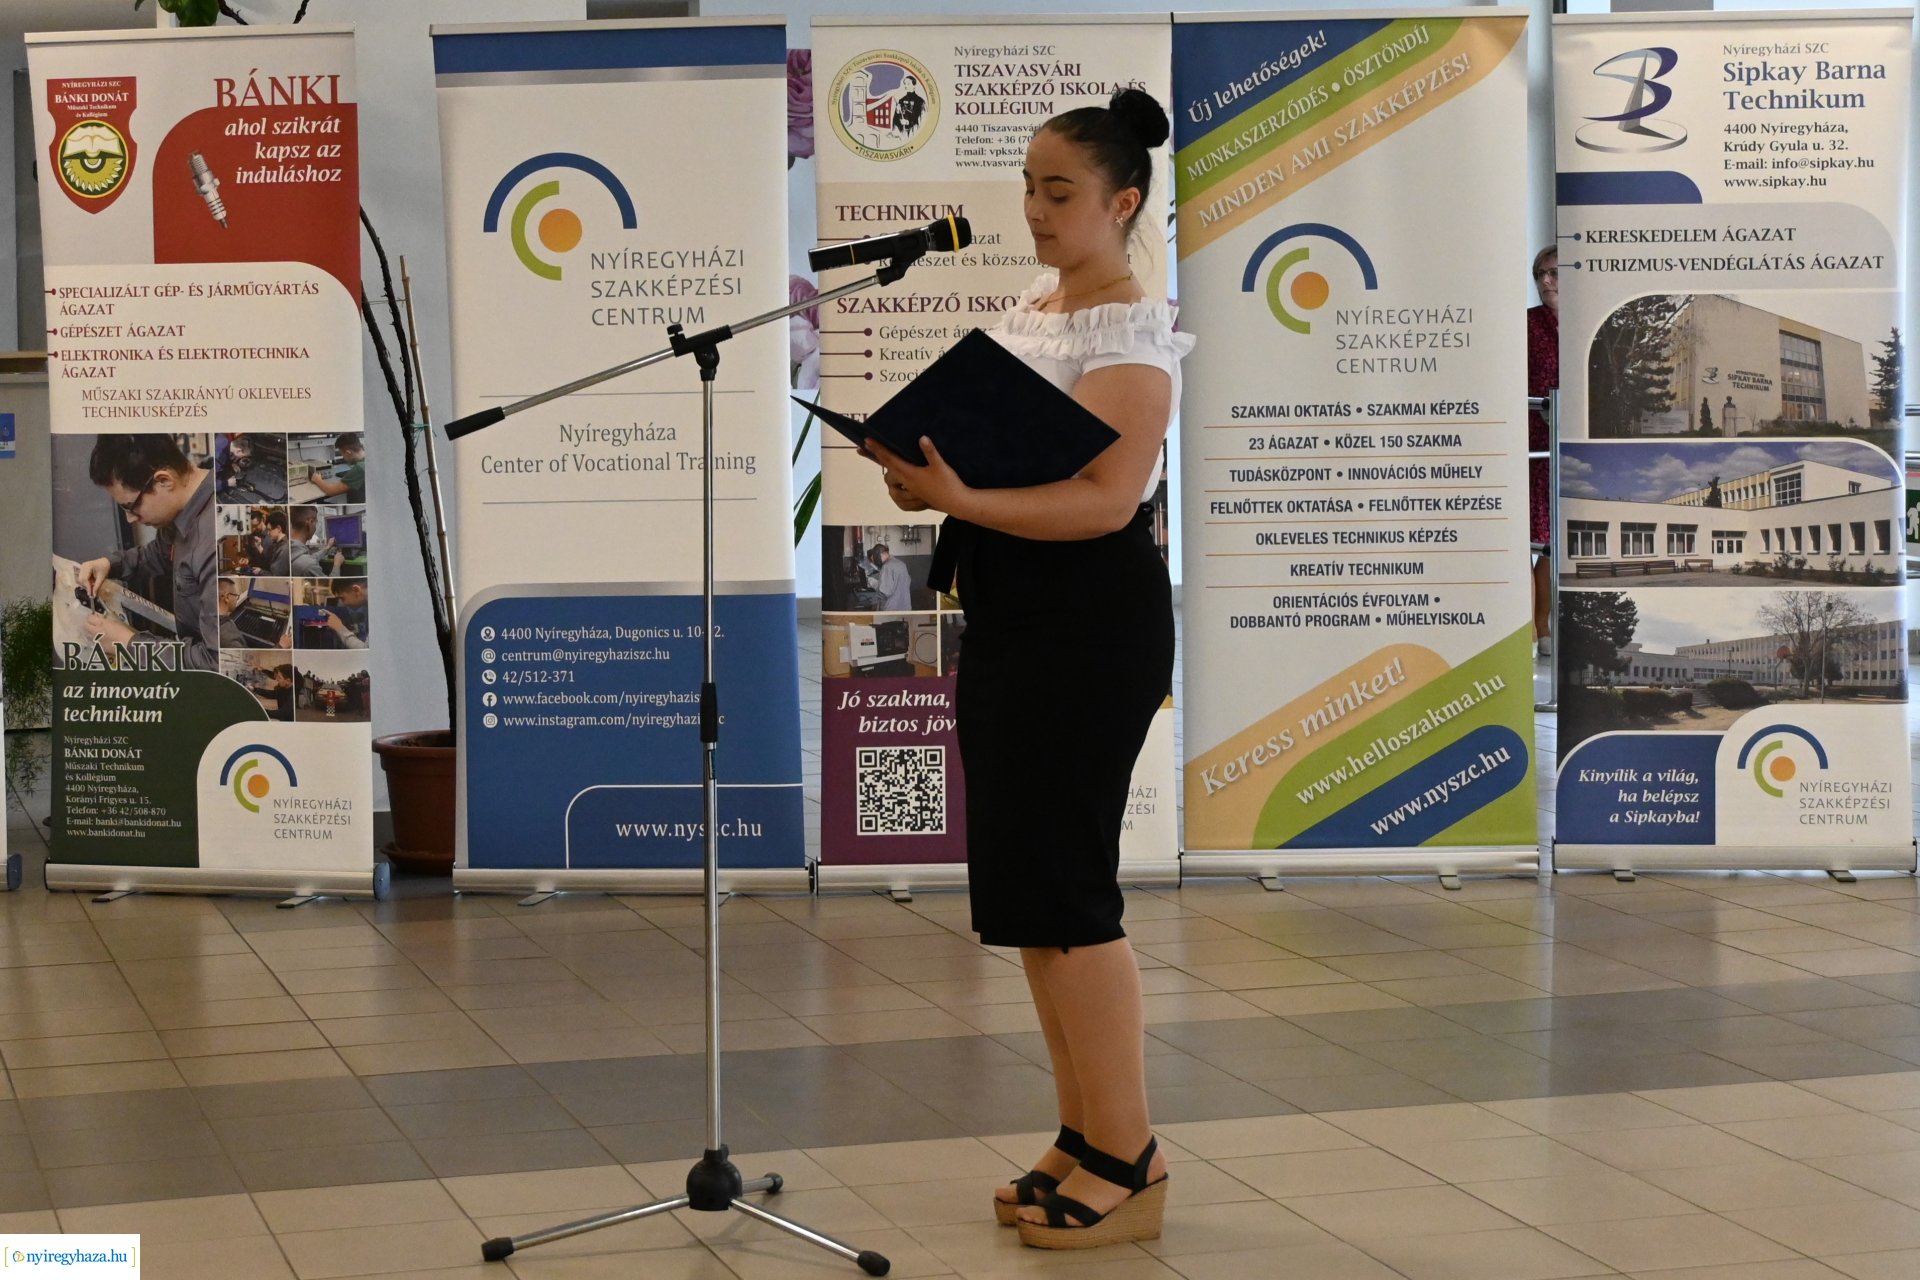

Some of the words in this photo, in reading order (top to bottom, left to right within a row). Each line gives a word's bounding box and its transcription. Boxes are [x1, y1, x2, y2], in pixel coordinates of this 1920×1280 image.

[954, 46, 1029, 58] Nyíregyházi
[1033, 45, 1056, 56] SZC
[1723, 43, 1801, 57] Nyíregyházi
[1805, 43, 1829, 54] SZC
[954, 60, 1081, 77] TISZAVASVÁRI
[1188, 101, 1211, 124] Új
[1214, 30, 1328, 109] lehetőségek!
[1723, 61, 1807, 86] Sipkay
[1816, 61, 1886, 80] Barna
[214, 68, 341, 107] BÁNKI
[954, 79, 1055, 96] SZAKKÉPZŐ
[1060, 81, 1122, 95] ISKOLA
[55, 92, 89, 104] BÁNKI
[91, 90, 129, 102] DONÁT
[1186, 83, 1329, 181] MUNKASZERZŐDÉS
[1343, 25, 1432, 87] ÖSZTÖNDÍJ
[1723, 89, 1865, 110] Technikum
[955, 99, 1053, 115] KOLLÉGIUM
[224, 118, 266, 136] ahol
[272, 117, 341, 135] szikrát
[955, 125, 979, 133] 4440
[1724, 123, 1757, 135] 4400
[1760, 123, 1848, 137] Nyíregyháza,
[955, 136, 994, 144] Telefon:
[996, 136, 1016, 144] +36
[1197, 164, 1285, 228] MINDEN
[1291, 140, 1331, 176] AMI
[1334, 52, 1472, 147] SZAKKÉPZÉS!
[1723, 141, 1765, 154] Krúdy
[1769, 140, 1808, 153] Gyula
[1829, 139, 1849, 151] 32.
[255, 142, 310, 161] kapsz
[316, 144, 341, 158] az
[859, 147, 912, 160] TISZAVASVÁRI
[955, 147, 987, 156] E-mail:
[1724, 158, 1768, 169] E-mail:
[1771, 157, 1874, 171] info@sipkay.hu
[236, 165, 342, 184] induláshoz
[1724, 175, 1827, 189] www.sipkay.hu
[835, 204, 964, 222] TECHNIKUM
[1586, 229, 1717, 243] KERESKEDELEM
[1721, 226, 1796, 242] ÁGAZAT
[590, 245, 744, 270] NYÍREGYHÁZI
[1586, 255, 1805, 272] TURIZMUS-VENDÉGLÁTÁS
[1810, 253, 1884, 271] ÁGAZAT
[58, 282, 150, 299] SPECIALIZÁLT
[154, 282, 184, 298] GÉP-
[188, 282, 204, 297] ÉS
[207, 282, 320, 298] JÁRMŰGYÁRTÁS
[591, 273, 742, 298] SZAKKÉPZÉSI
[59, 301, 115, 316] ÁGAZAT
[837, 292, 961, 314] SZAKKÉPZŐ
[591, 306, 705, 327] CENTRUM
[1336, 305, 1473, 326] NYÍREGYHÁZI
[60, 323, 122, 339] GÉPÉSZET
[127, 322, 186, 338] ÁGAZAT
[879, 324, 948, 343] Gépészet
[1336, 329, 1471, 351] SZAKKÉPZÉSI
[60, 348, 154, 362] ELEKTRONIKA
[158, 345, 174, 360] ÉS
[178, 347, 310, 360] ELEKTROTECHNIKA
[879, 346, 934, 362] Kreatív
[61, 363, 116, 379] ÁGAZAT
[1337, 358, 1437, 374] CENTRUM
[81, 385, 142, 402] MŰSZAKI
[146, 385, 234, 401] SZAKIRÁNYÚ
[238, 386, 312, 400] OKLEVELES
[1732, 382, 1770, 391] TECHNIKUM
[82, 402, 208, 418] TECHNIKUSKÉPZÉS
[1231, 404, 1290, 418] SZAKMAI
[1294, 401, 1351, 417] OKTATÁS
[1367, 403, 1425, 417] SZAKMAI
[1430, 400, 1479, 416] KÉPZÉS
[559, 422, 677, 447] Nyíregyháza
[1249, 438, 1265, 451] 23
[1268, 433, 1319, 450] ÁGAZAT
[1335, 433, 1376, 449] KÖZEL
[1380, 435, 1402, 449] 150
[1406, 434, 1462, 448] SZAKMA
[481, 455, 543, 474] Center
[549, 453, 567, 473] of
[573, 453, 670, 472] Vocational
[676, 452, 756, 476] Traning
[1229, 466, 1332, 482] TUDÁSKÖZPONT
[1348, 464, 1427, 480] INNOVÁCIÓS
[1430, 464, 1483, 479] MŰHELY
[1210, 497, 1283, 514] FELNŐTTEK
[1287, 497, 1353, 514] OKTATÁSA
[1369, 495, 1442, 512] FELNŐTTEK
[1446, 494, 1502, 510] KÉPZÉSE
[1255, 532, 1328, 546] OKLEVELES
[1332, 530, 1405, 545] TECHNIKUS
[1409, 527, 1458, 543] KÉPZÉS
[1290, 561, 1344, 577] KREATÍV
[1349, 562, 1424, 576] TECHNIKUM
[1273, 592, 1358, 609] ORIENTÁCIÓS
[1362, 592, 1429, 607] ÉVFOLYAM
[1230, 612, 1301, 628] DOBBANTÓ
[1305, 614, 1370, 627] PROGRAM
[1386, 609, 1485, 626] MŰHELYISKOLA
[501, 628, 532, 640] 4400
[535, 626, 612, 643] Nyíregyháza,
[615, 626, 669, 641] Dugonics
[62, 633, 186, 672] BÁNKI
[501, 648, 670, 663] centrum@nyiregyhaziszc.hu
[503, 670, 575, 686] 42/512-371
[63, 685, 84, 699] az
[90, 681, 180, 700] innovatív
[503, 691, 701, 707] www.facebook.com/nyiregyhazis
[837, 690, 860, 711] Jó
[866, 690, 950, 709] szakma,
[63, 705, 163, 723] technikum
[503, 712, 724, 729] www.instagram.com/nyiregyhazic
[858, 716, 918, 734] biztos
[1199, 727, 1295, 798] Keress
[1299, 657, 1406, 738] minket!
[64, 735, 111, 746] Nyíregyházi
[113, 735, 129, 744] SZC
[1295, 672, 1506, 805] www.helloszakma.hu
[64, 747, 99, 759] BÁNKI
[101, 746, 142, 759] DONÁT
[65, 761, 98, 771] Műszaki
[100, 761, 144, 771] Technikum
[76, 772, 116, 783] Kollégium
[1579, 768, 1638, 785] Kinyílik
[1657, 768, 1699, 785] világ,
[65, 784, 85, 793] 4400
[87, 784, 139, 795] Nyíregyháza,
[1370, 745, 1511, 836] www.nyszc.hu
[1799, 779, 1892, 794] NYÍREGYHÁZI
[66, 794, 97, 806] Korányi
[99, 795, 127, 806] Frigyes
[274, 797, 352, 810] NYÍREGYHÁZI
[1618, 790, 1637, 803] ha
[1642, 789, 1699, 806] belépsz
[1799, 796, 1890, 809] SZAKKÉPZÉSI
[66, 806, 99, 815] Telefon:
[117, 806, 166, 816] 42/508-870
[274, 812, 351, 825] SZAKKÉPZÉSI
[1624, 810, 1699, 826] Sipkayba!
[1799, 814, 1868, 825] CENTRUM
[66, 816, 93, 826] E-mail:
[95, 816, 181, 828] banki@bankidonat.hu
[616, 817, 763, 841] www.nysc.hu
[67, 828, 145, 838] www.bankidonat.hu
[274, 828, 333, 840] CENTRUM
